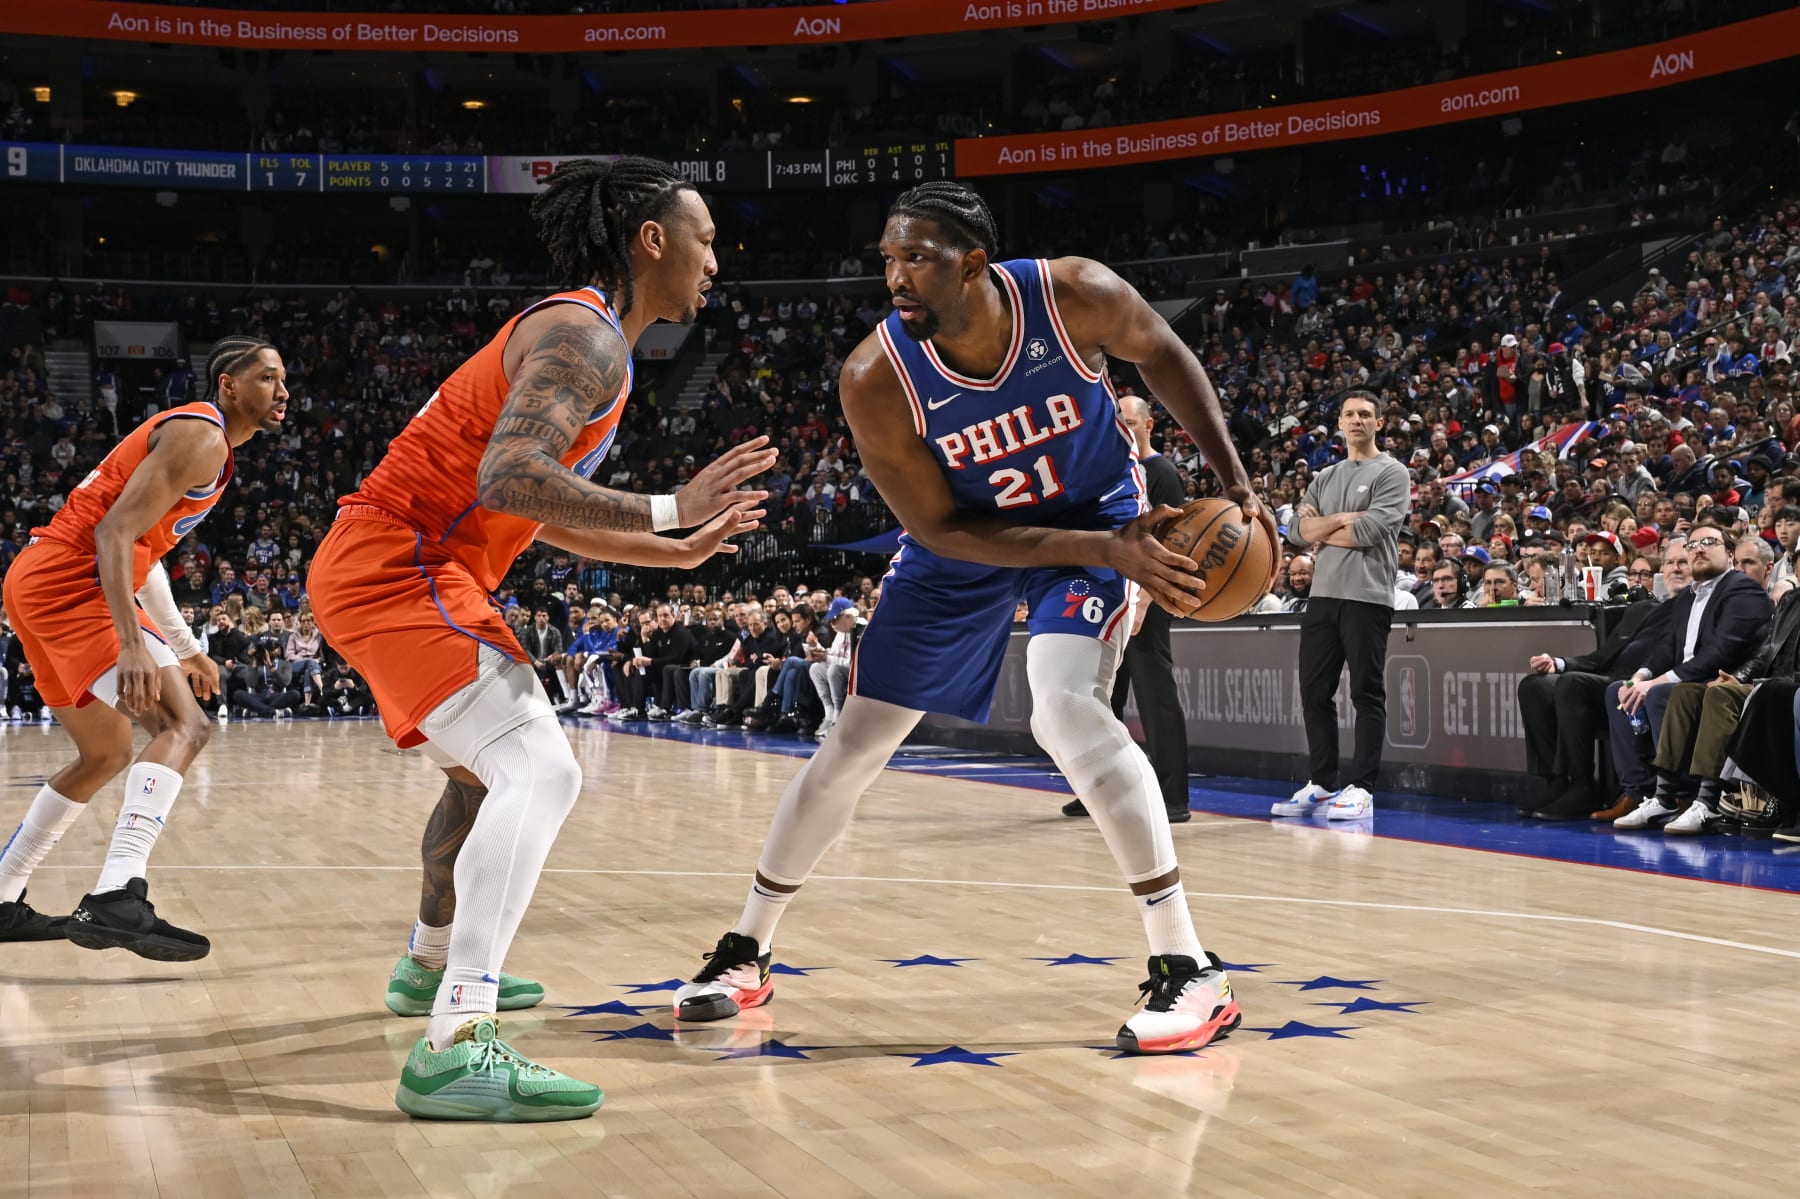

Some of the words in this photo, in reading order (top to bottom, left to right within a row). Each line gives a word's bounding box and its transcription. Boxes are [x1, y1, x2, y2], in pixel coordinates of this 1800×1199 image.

[962, 3, 1001, 21] Aon
[1007, 1, 1022, 17] is
[1026, 1, 1043, 16] in
[1047, 0, 1078, 14] the
[108, 12, 149, 32] Aon
[155, 15, 171, 33] is
[177, 17, 194, 35] in
[199, 18, 232, 37] the
[238, 21, 327, 41] Business
[332, 23, 352, 40] of
[357, 24, 418, 42] Better
[424, 25, 519, 43] Decisions
[584, 26, 666, 42] aon.com
[794, 17, 841, 36] AON
[1650, 49, 1694, 78] AON
[1440, 85, 1520, 112] aon.com
[997, 145, 1037, 165] Aon
[1041, 142, 1057, 161] is
[1061, 141, 1077, 159] in
[1082, 138, 1113, 158] the
[1117, 131, 1198, 155] Business
[1201, 124, 1221, 145] of
[1225, 119, 1283, 143] Better
[1288, 108, 1380, 136] Decisions
[888, 146, 903, 154] AST
[911, 144, 927, 152] BLK
[7, 146, 28, 178] 9
[74, 156, 140, 175] OKLAHOMA
[143, 160, 170, 176] CITY
[175, 161, 237, 179] THUNDER
[260, 157, 279, 169] FLS
[290, 157, 311, 169] TOL
[328, 160, 372, 172] PLAYER
[380, 161, 389, 172] 5
[402, 161, 411, 172] 6
[423, 161, 431, 172] 7
[445, 161, 453, 173] 3
[463, 162, 477, 173] 21
[715, 159, 726, 183] 8
[775, 164, 800, 175] 7:43
[803, 163, 822, 175] PM
[836, 160, 855, 172] PHI
[868, 158, 875, 169] 0
[893, 157, 899, 167] 1
[914, 155, 923, 166] 0
[940, 153, 946, 163] 1
[265, 171, 274, 187] 1
[295, 171, 307, 187] 7
[329, 176, 372, 188] POINTS
[380, 176, 390, 187] 0
[401, 176, 411, 187] 0
[423, 176, 432, 187] 5
[445, 176, 453, 188] 2
[466, 177, 475, 188] 2
[834, 173, 859, 185] OKC
[868, 172, 875, 182] 3
[892, 170, 900, 181] 4
[915, 169, 923, 179] 0
[940, 167, 946, 177] 1
[99, 345, 120, 356] 107
[151, 346, 174, 357] 106
[1025, 354, 1064, 377] crypto.com
[542, 366, 597, 400] ARKANSAS
[935, 393, 1084, 470] PHILA
[988, 455, 1065, 509] 21
[1062, 592, 1105, 624] 76
[1197, 667, 1222, 721] ALL
[1224, 667, 1287, 725] SEASON.
[1442, 670, 1482, 736] GET
